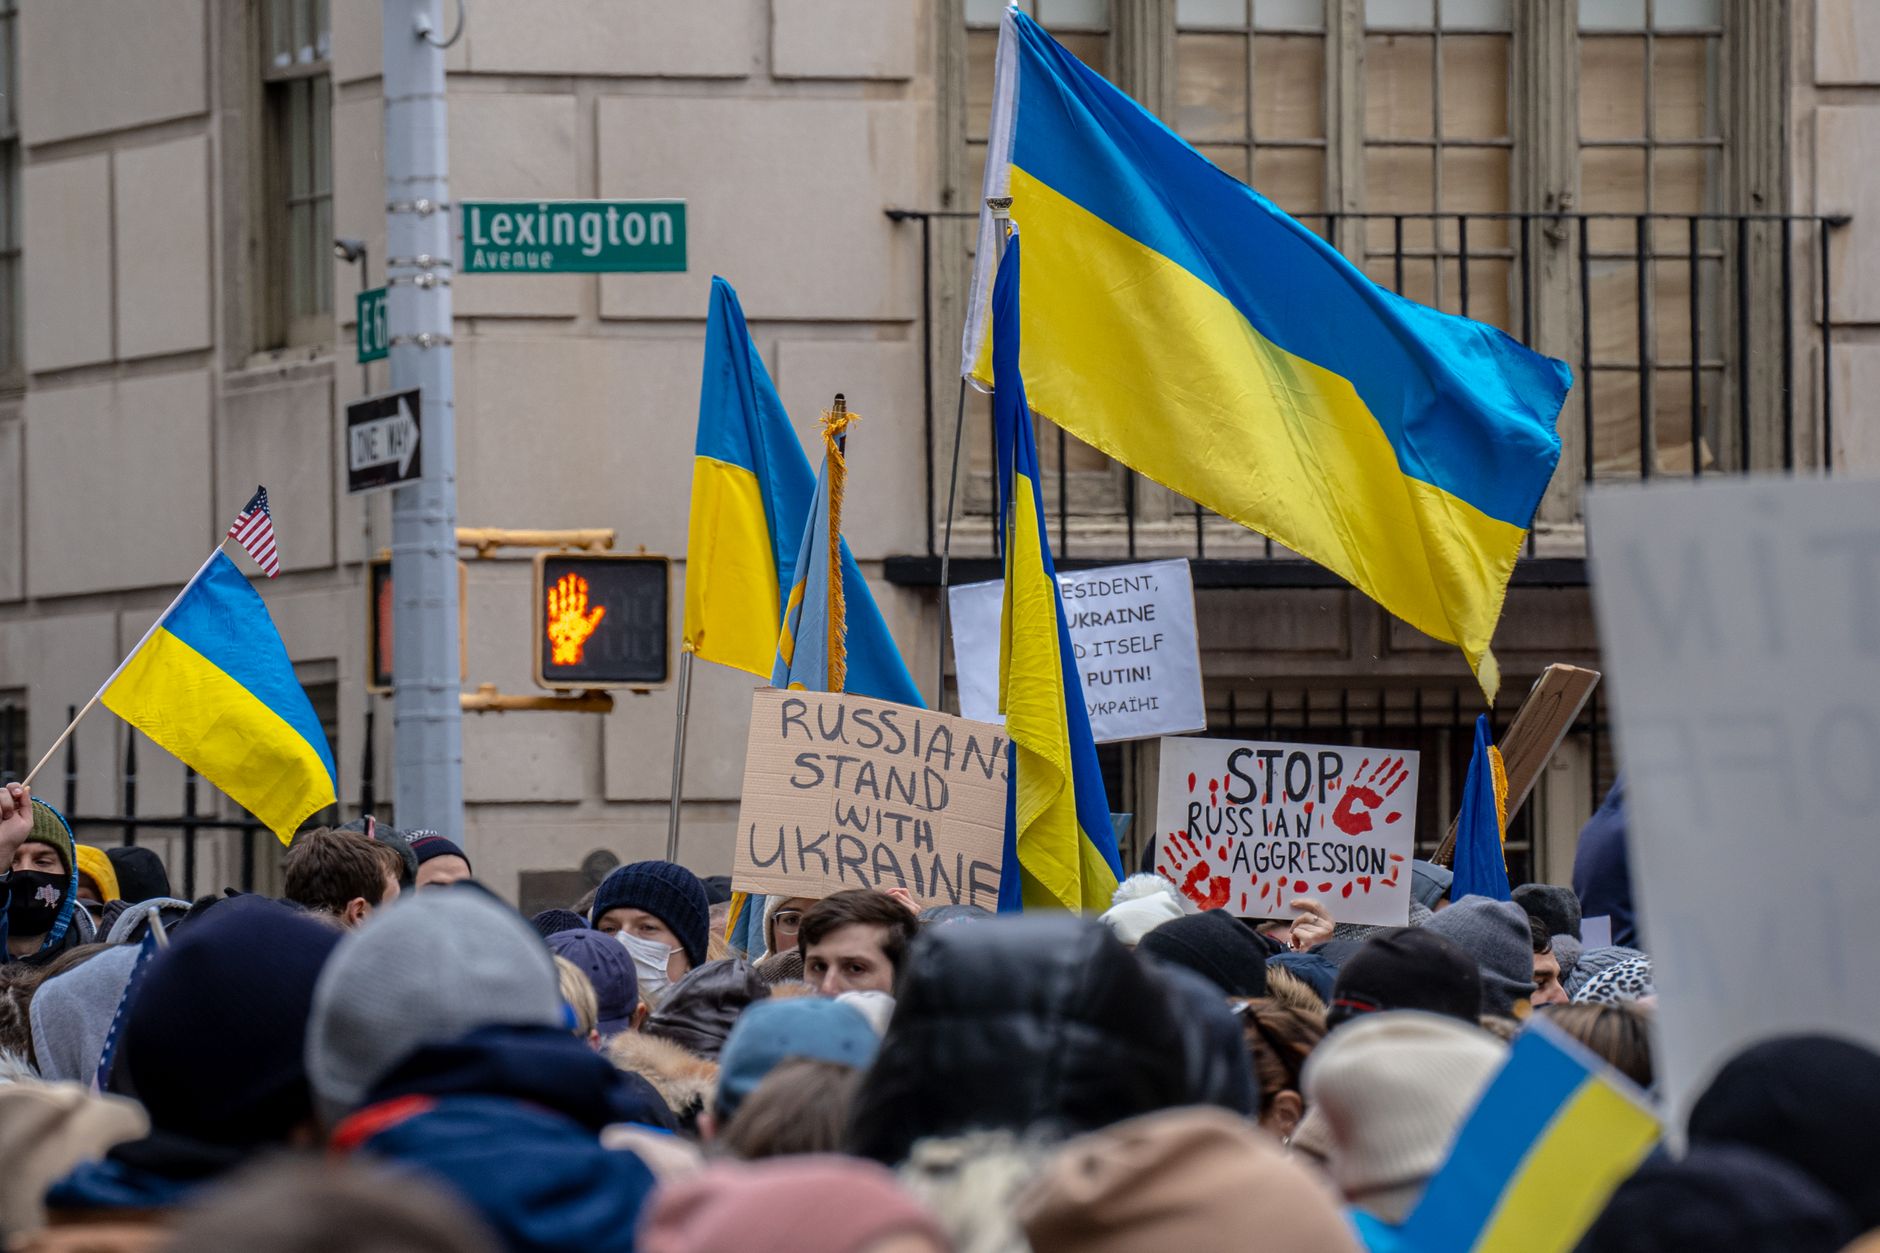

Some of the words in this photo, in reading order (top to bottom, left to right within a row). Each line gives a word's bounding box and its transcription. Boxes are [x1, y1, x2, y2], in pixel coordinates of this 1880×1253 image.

[470, 204, 674, 256] Lexington
[472, 248, 554, 269] Avenue
[362, 301, 372, 352] E
[356, 425, 378, 464] ONE
[386, 418, 410, 457] WAY
[1061, 575, 1159, 599] ESIDENT,
[1093, 633, 1164, 658] ITSELF
[1087, 665, 1152, 686] PUTIN!
[790, 752, 949, 811] STAND
[1225, 747, 1343, 804] STOP
[835, 798, 934, 853] WITH
[1187, 801, 1312, 841] RUSSIAN
[1232, 841, 1386, 875] AGGRESSION
